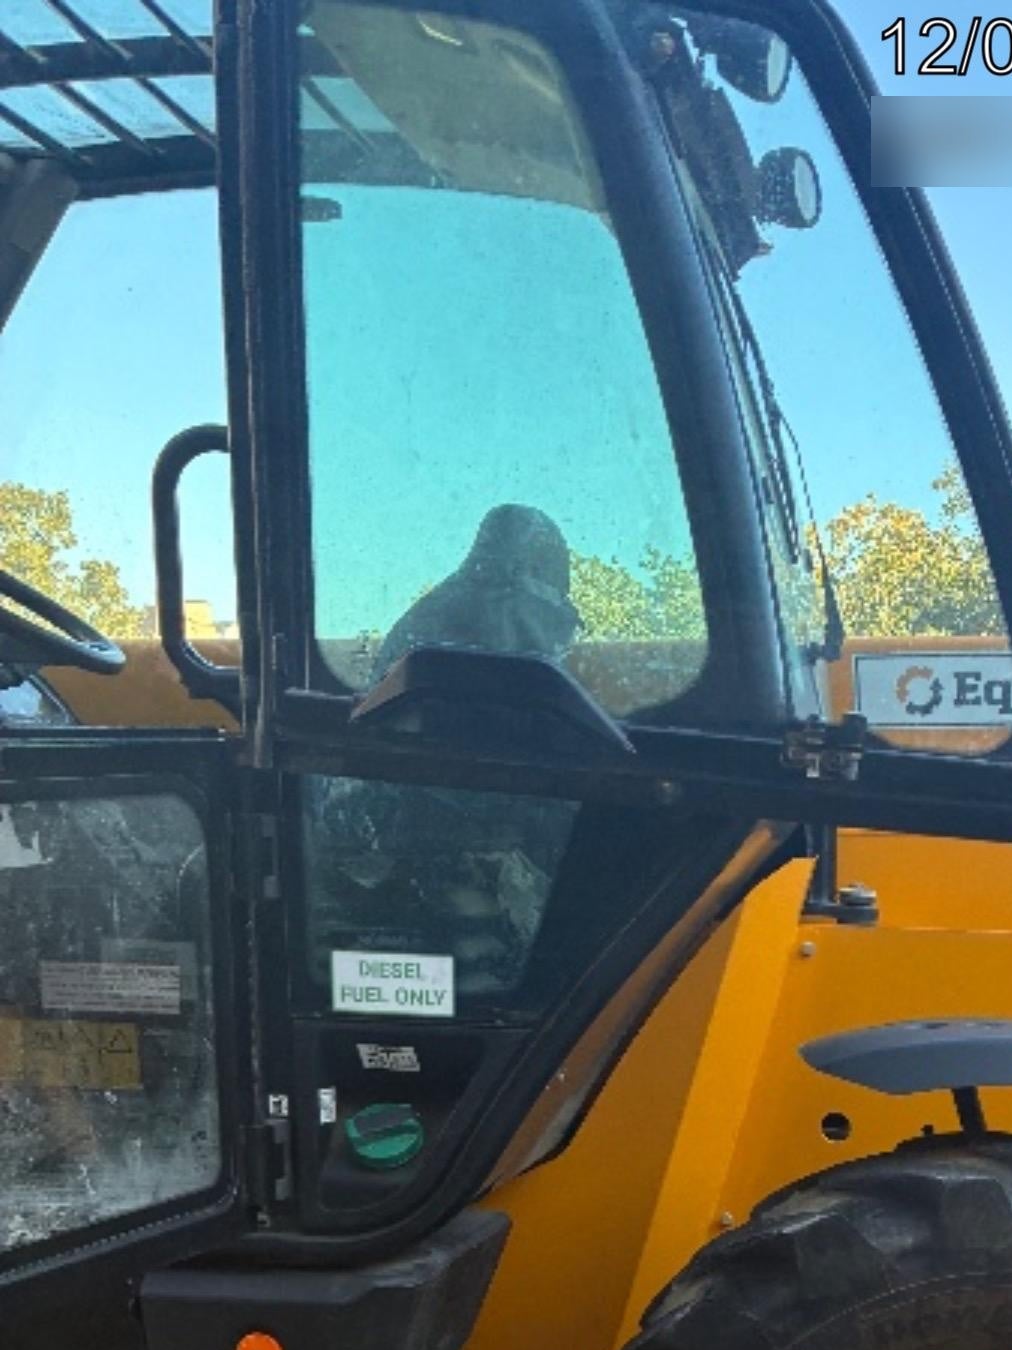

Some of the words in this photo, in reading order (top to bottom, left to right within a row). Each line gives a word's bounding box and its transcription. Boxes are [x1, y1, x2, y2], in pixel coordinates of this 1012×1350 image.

[359, 960, 425, 980] DIESEL
[341, 985, 387, 1003] FUEL
[395, 986, 448, 1006] ONLY
